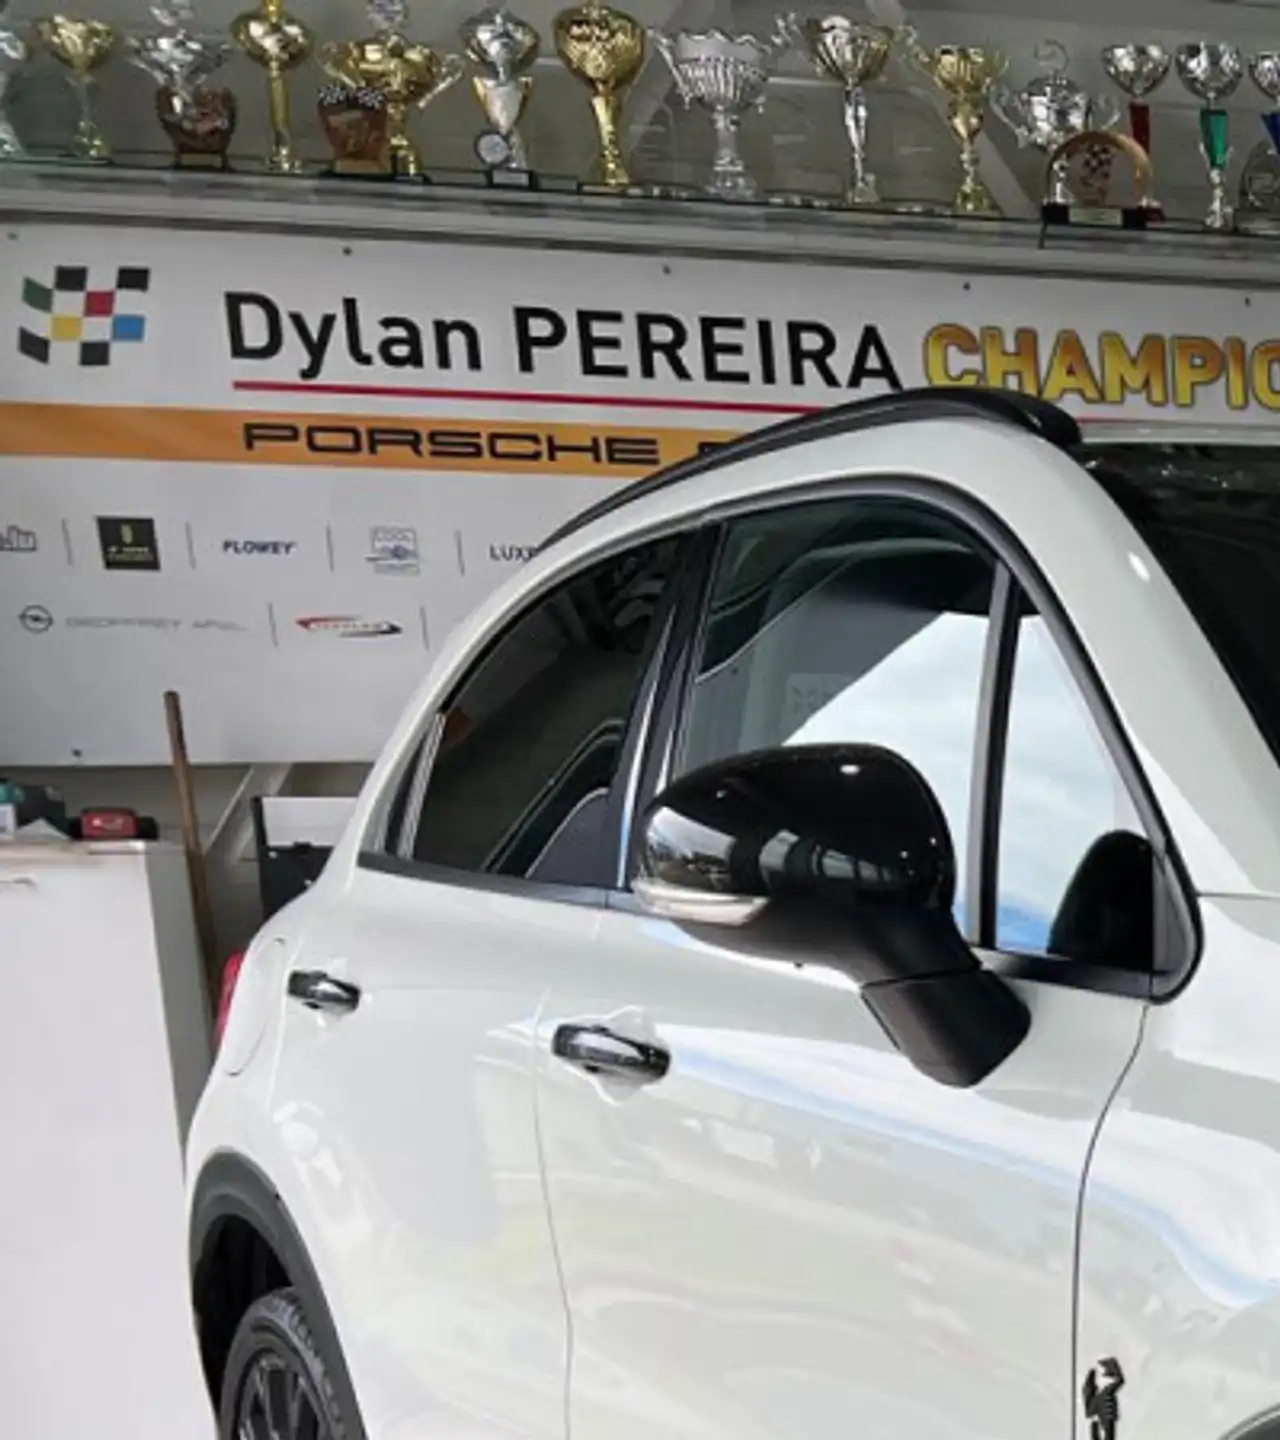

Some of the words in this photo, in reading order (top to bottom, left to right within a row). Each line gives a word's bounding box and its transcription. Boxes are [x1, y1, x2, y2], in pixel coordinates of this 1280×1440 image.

[224, 291, 482, 381] Dylan
[513, 305, 904, 391] PEREIRA
[243, 421, 660, 467] PORSCHE
